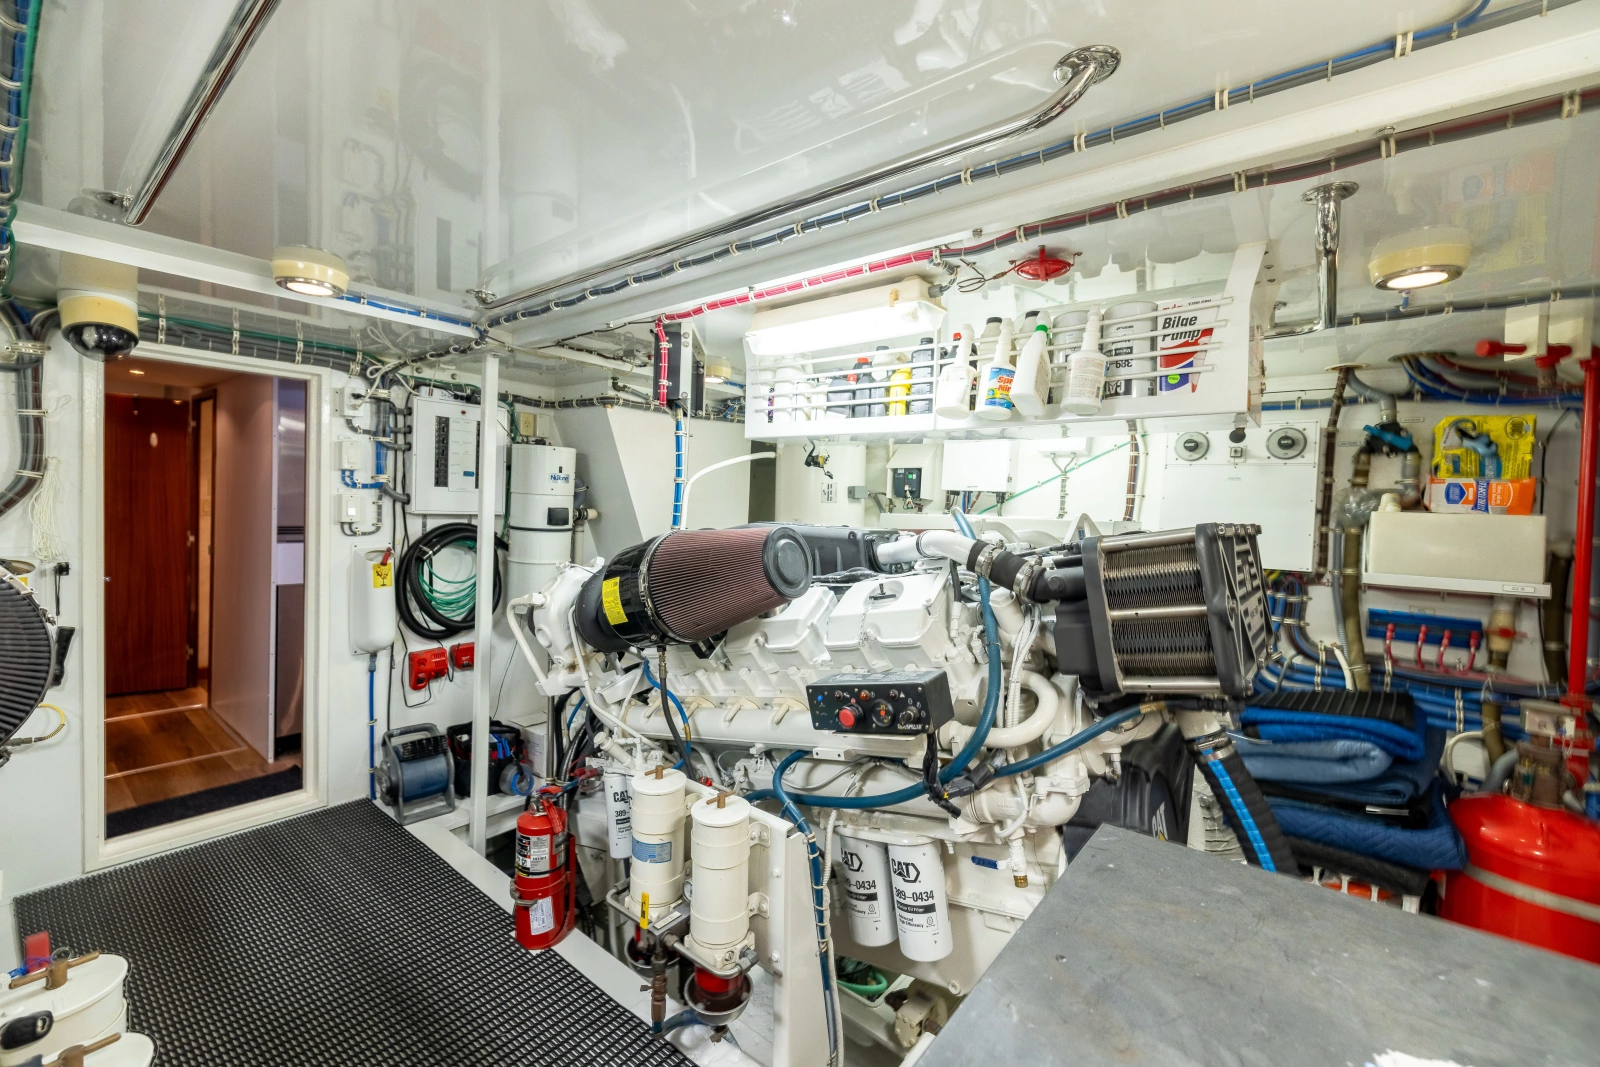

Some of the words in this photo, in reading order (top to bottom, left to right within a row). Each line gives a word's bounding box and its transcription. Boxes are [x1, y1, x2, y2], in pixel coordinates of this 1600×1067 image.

[1152, 801, 1168, 840] CAT
[892, 858, 910, 878] CAT
[895, 886, 934, 902] 389-0434
